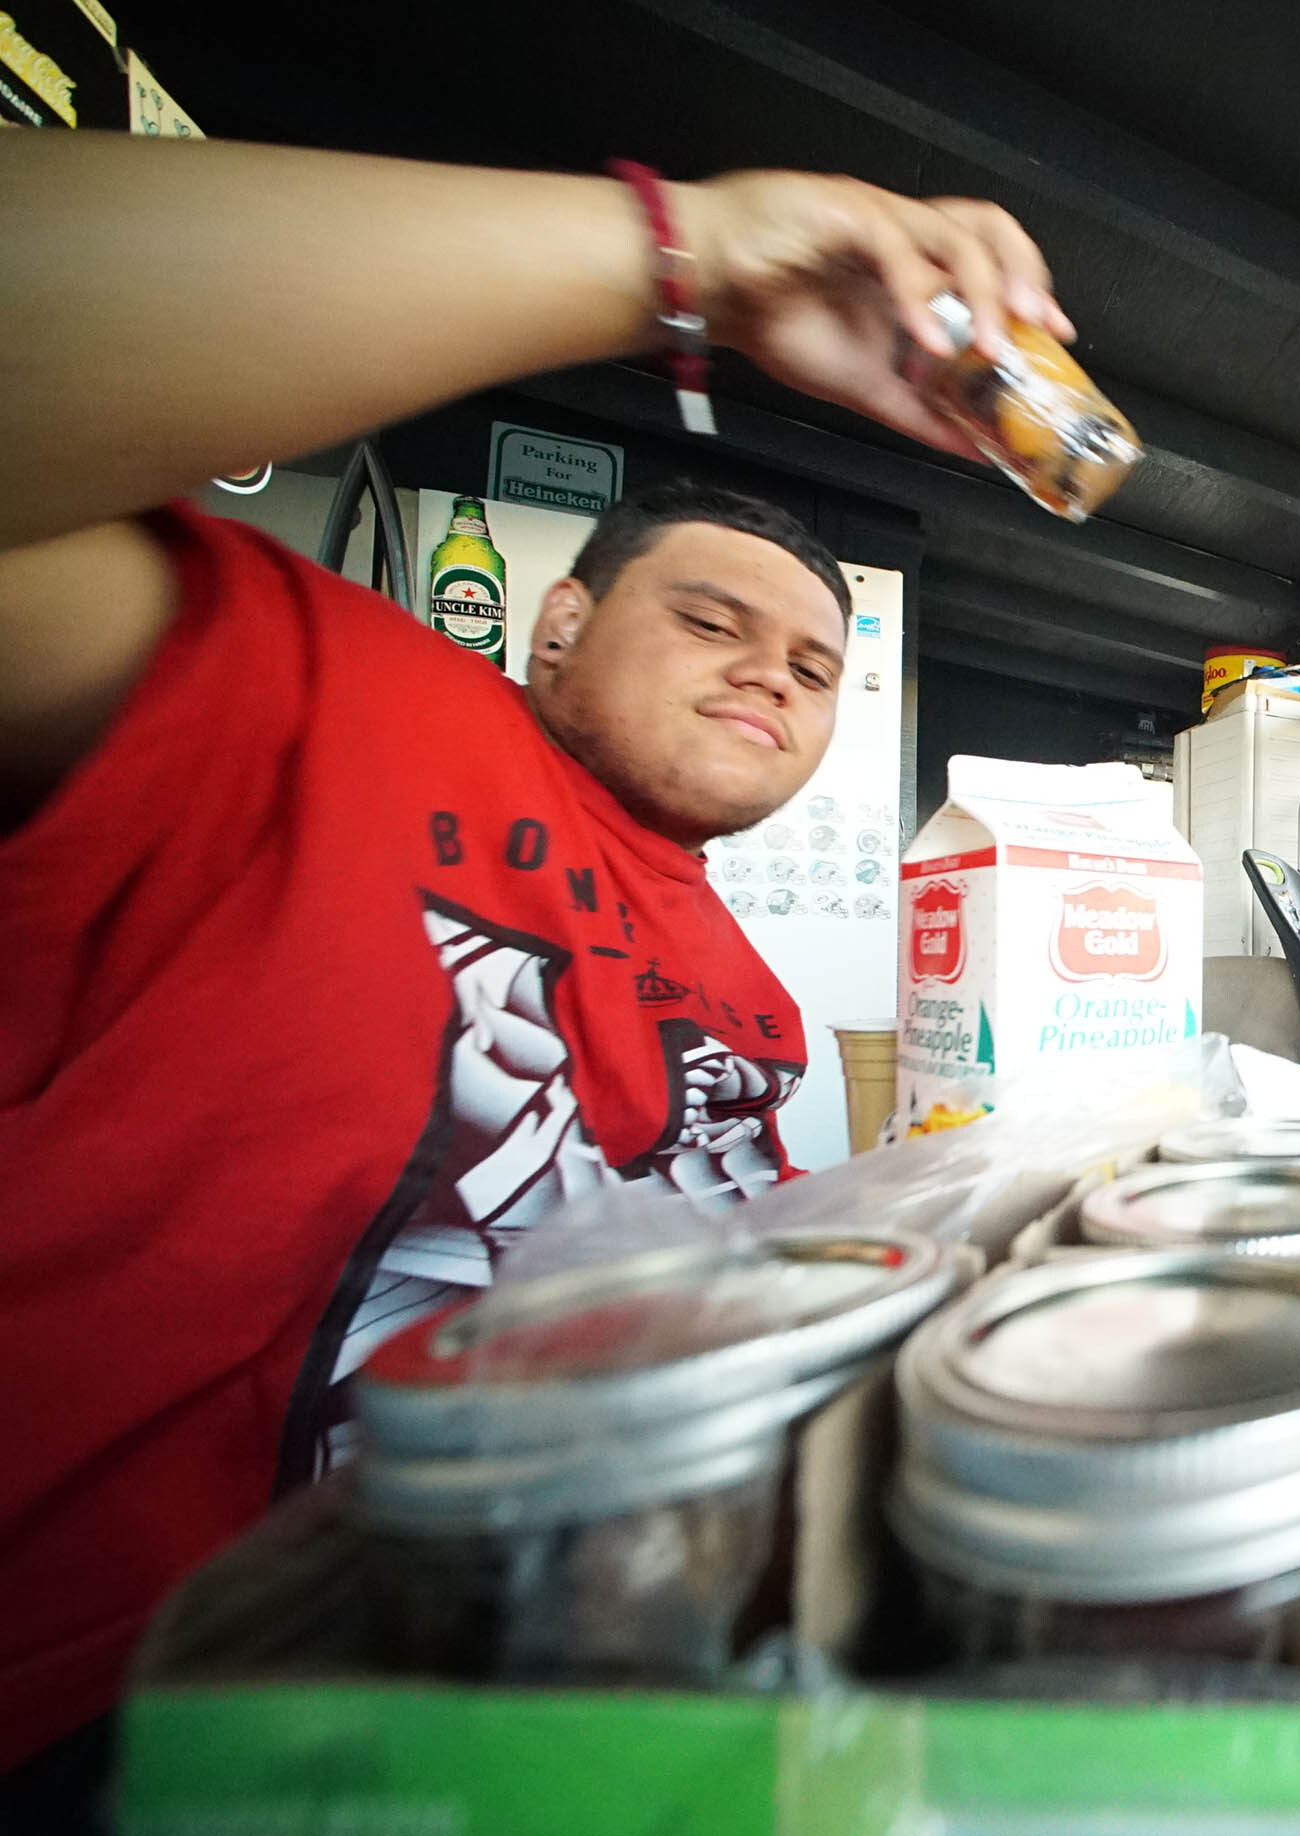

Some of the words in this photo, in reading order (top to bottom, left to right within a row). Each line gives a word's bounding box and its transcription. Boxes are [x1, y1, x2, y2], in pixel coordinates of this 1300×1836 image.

[521, 444, 598, 473] Parking
[546, 467, 573, 480] For
[507, 480, 603, 511] Heineken
[435, 601, 477, 616] UNCLE
[479, 605, 502, 619] KIM
[1204, 664, 1227, 686] gloo
[1064, 903, 1156, 931] Meadow
[1084, 929, 1139, 955] Gold
[1055, 992, 1167, 1025] Orange-
[1038, 1017, 1178, 1052] Pineapple
